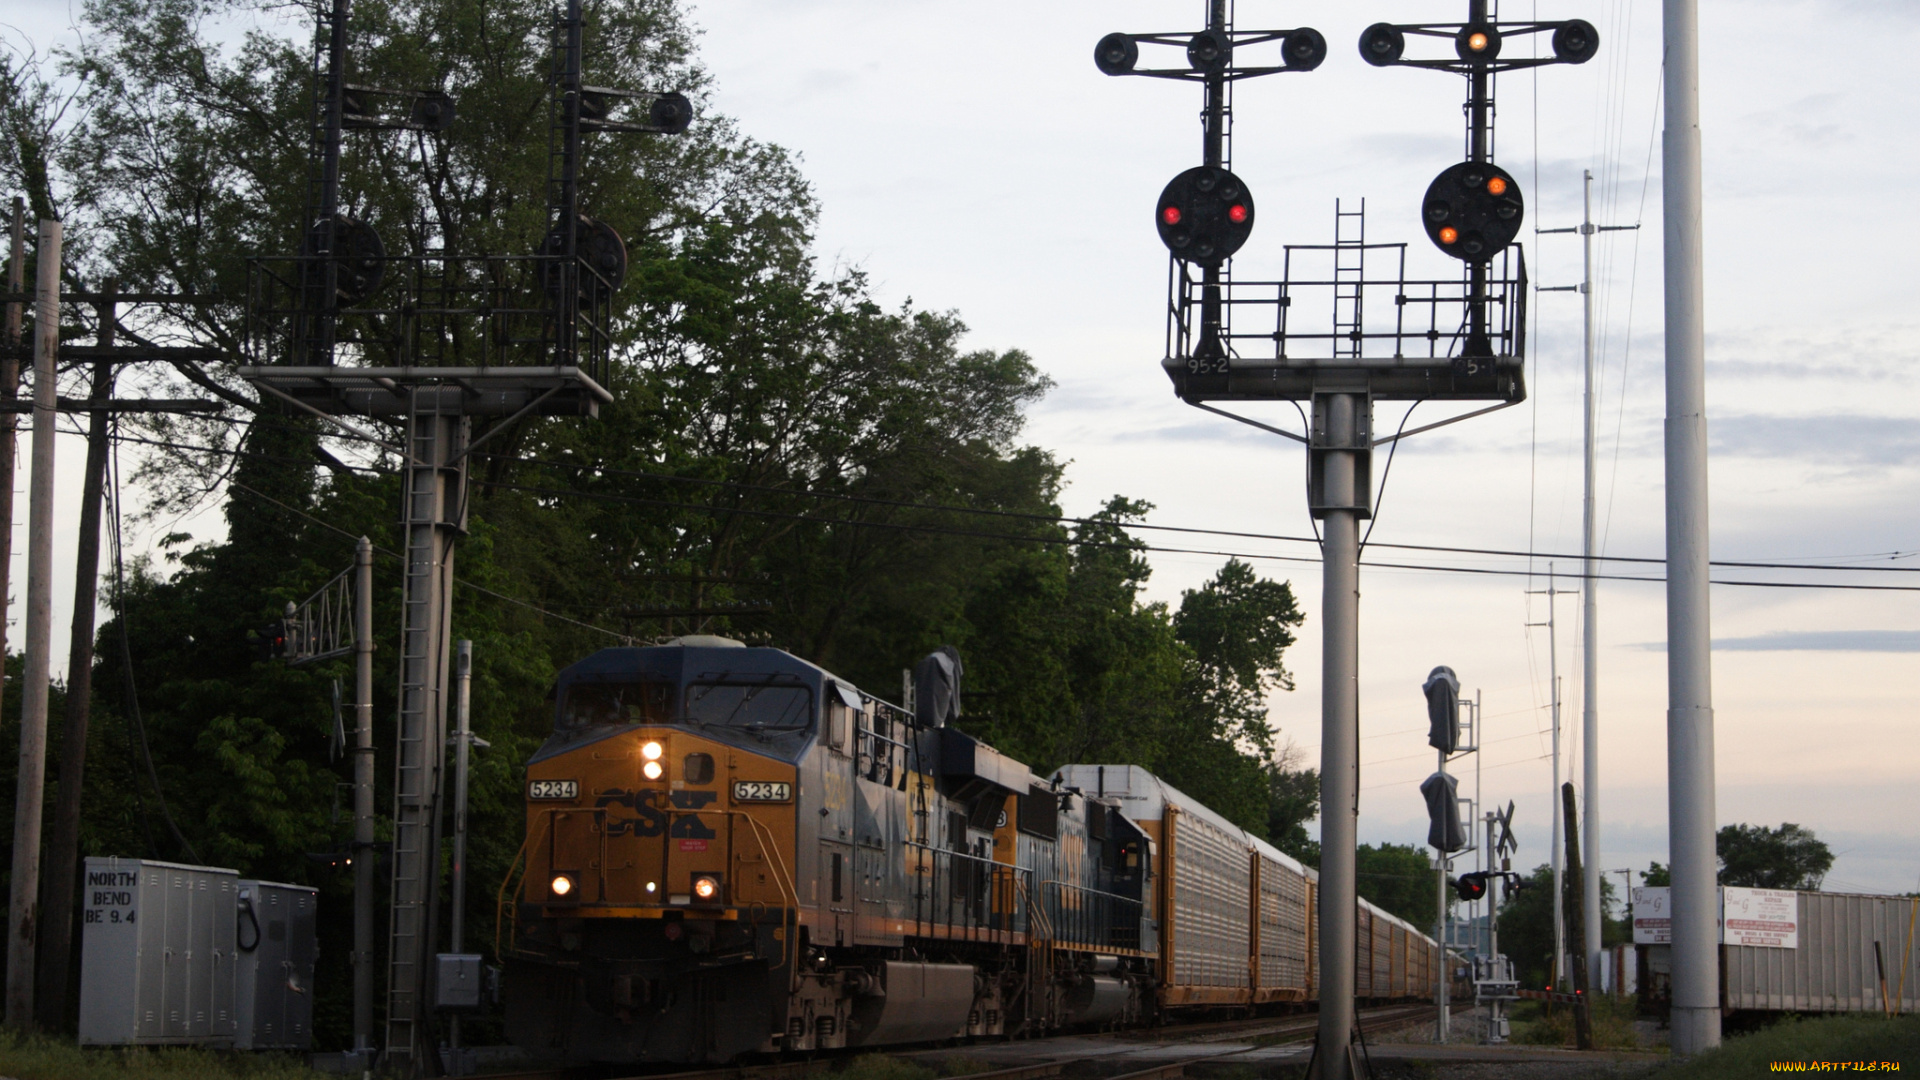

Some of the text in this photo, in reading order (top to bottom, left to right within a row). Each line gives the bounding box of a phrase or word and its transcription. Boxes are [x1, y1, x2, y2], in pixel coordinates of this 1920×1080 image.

[1188, 357, 1228, 374] 95-2
[534, 782, 573, 796] 5234
[738, 783, 785, 799] 5234
[594, 788, 717, 839] CSX
[89, 872, 136, 886] NORTH
[94, 892, 131, 905] BEND
[85, 909, 104, 923] BE
